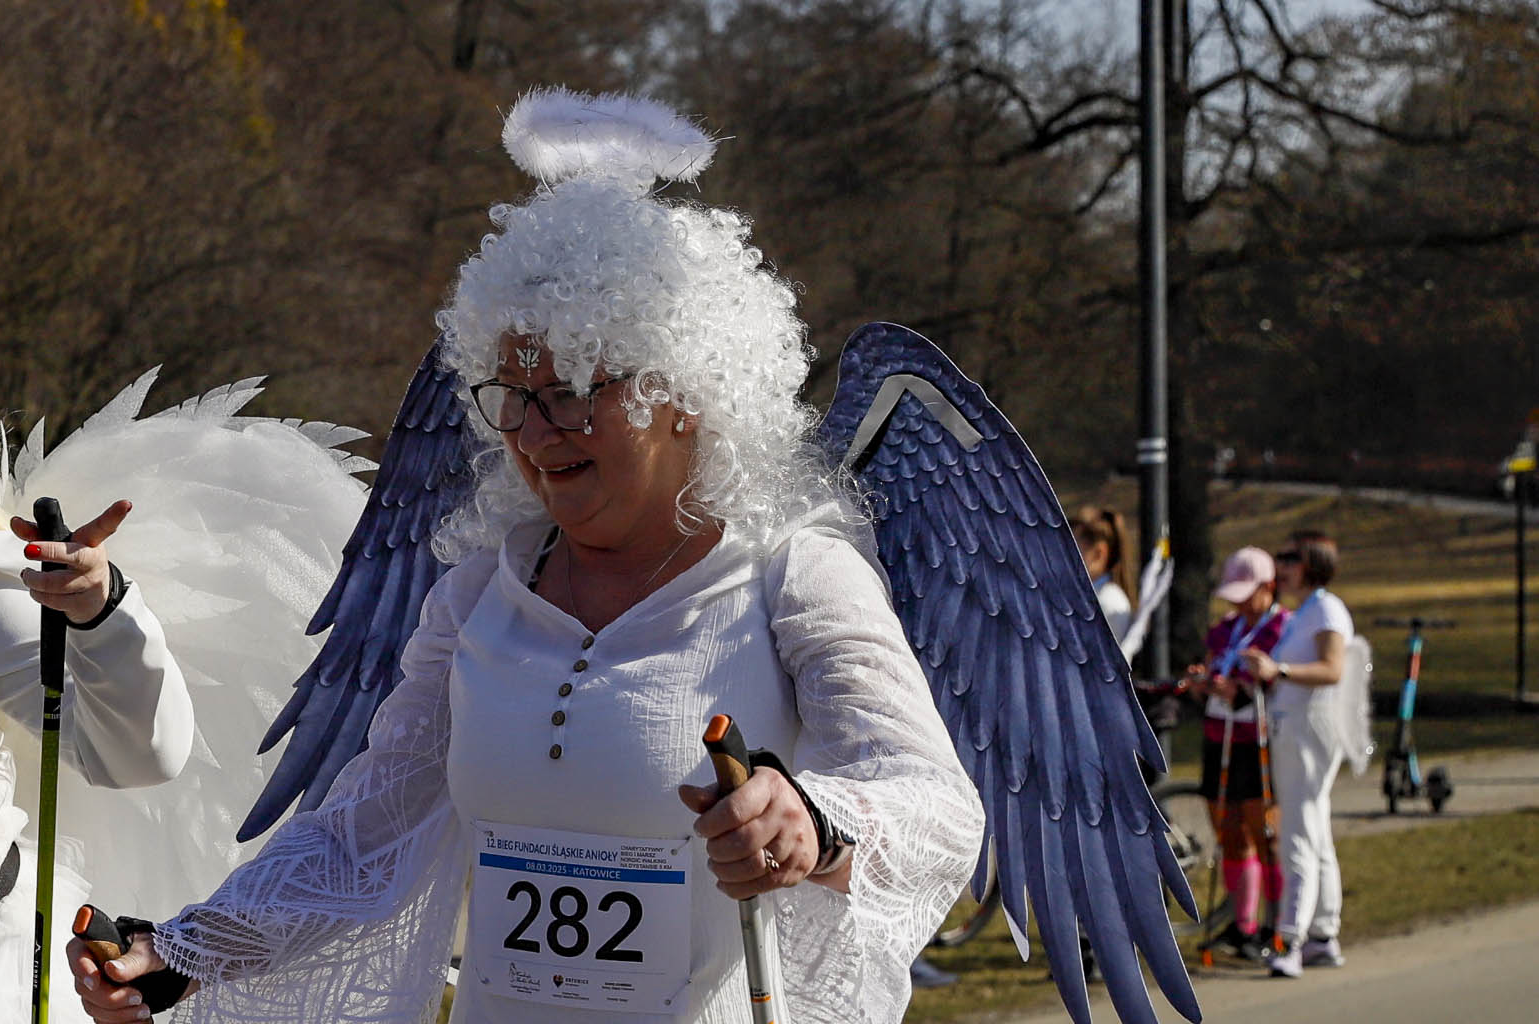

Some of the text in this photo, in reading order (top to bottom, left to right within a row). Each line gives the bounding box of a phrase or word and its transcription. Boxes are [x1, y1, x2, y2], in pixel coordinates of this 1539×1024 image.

[497, 839, 513, 850] BIEG
[514, 841, 551, 856] FUNDACJI
[551, 844, 585, 859] ŚLĄSKIE
[585, 848, 618, 862] ANIOŁY
[572, 867, 621, 880] KATOWICE
[503, 880, 644, 963] 282
